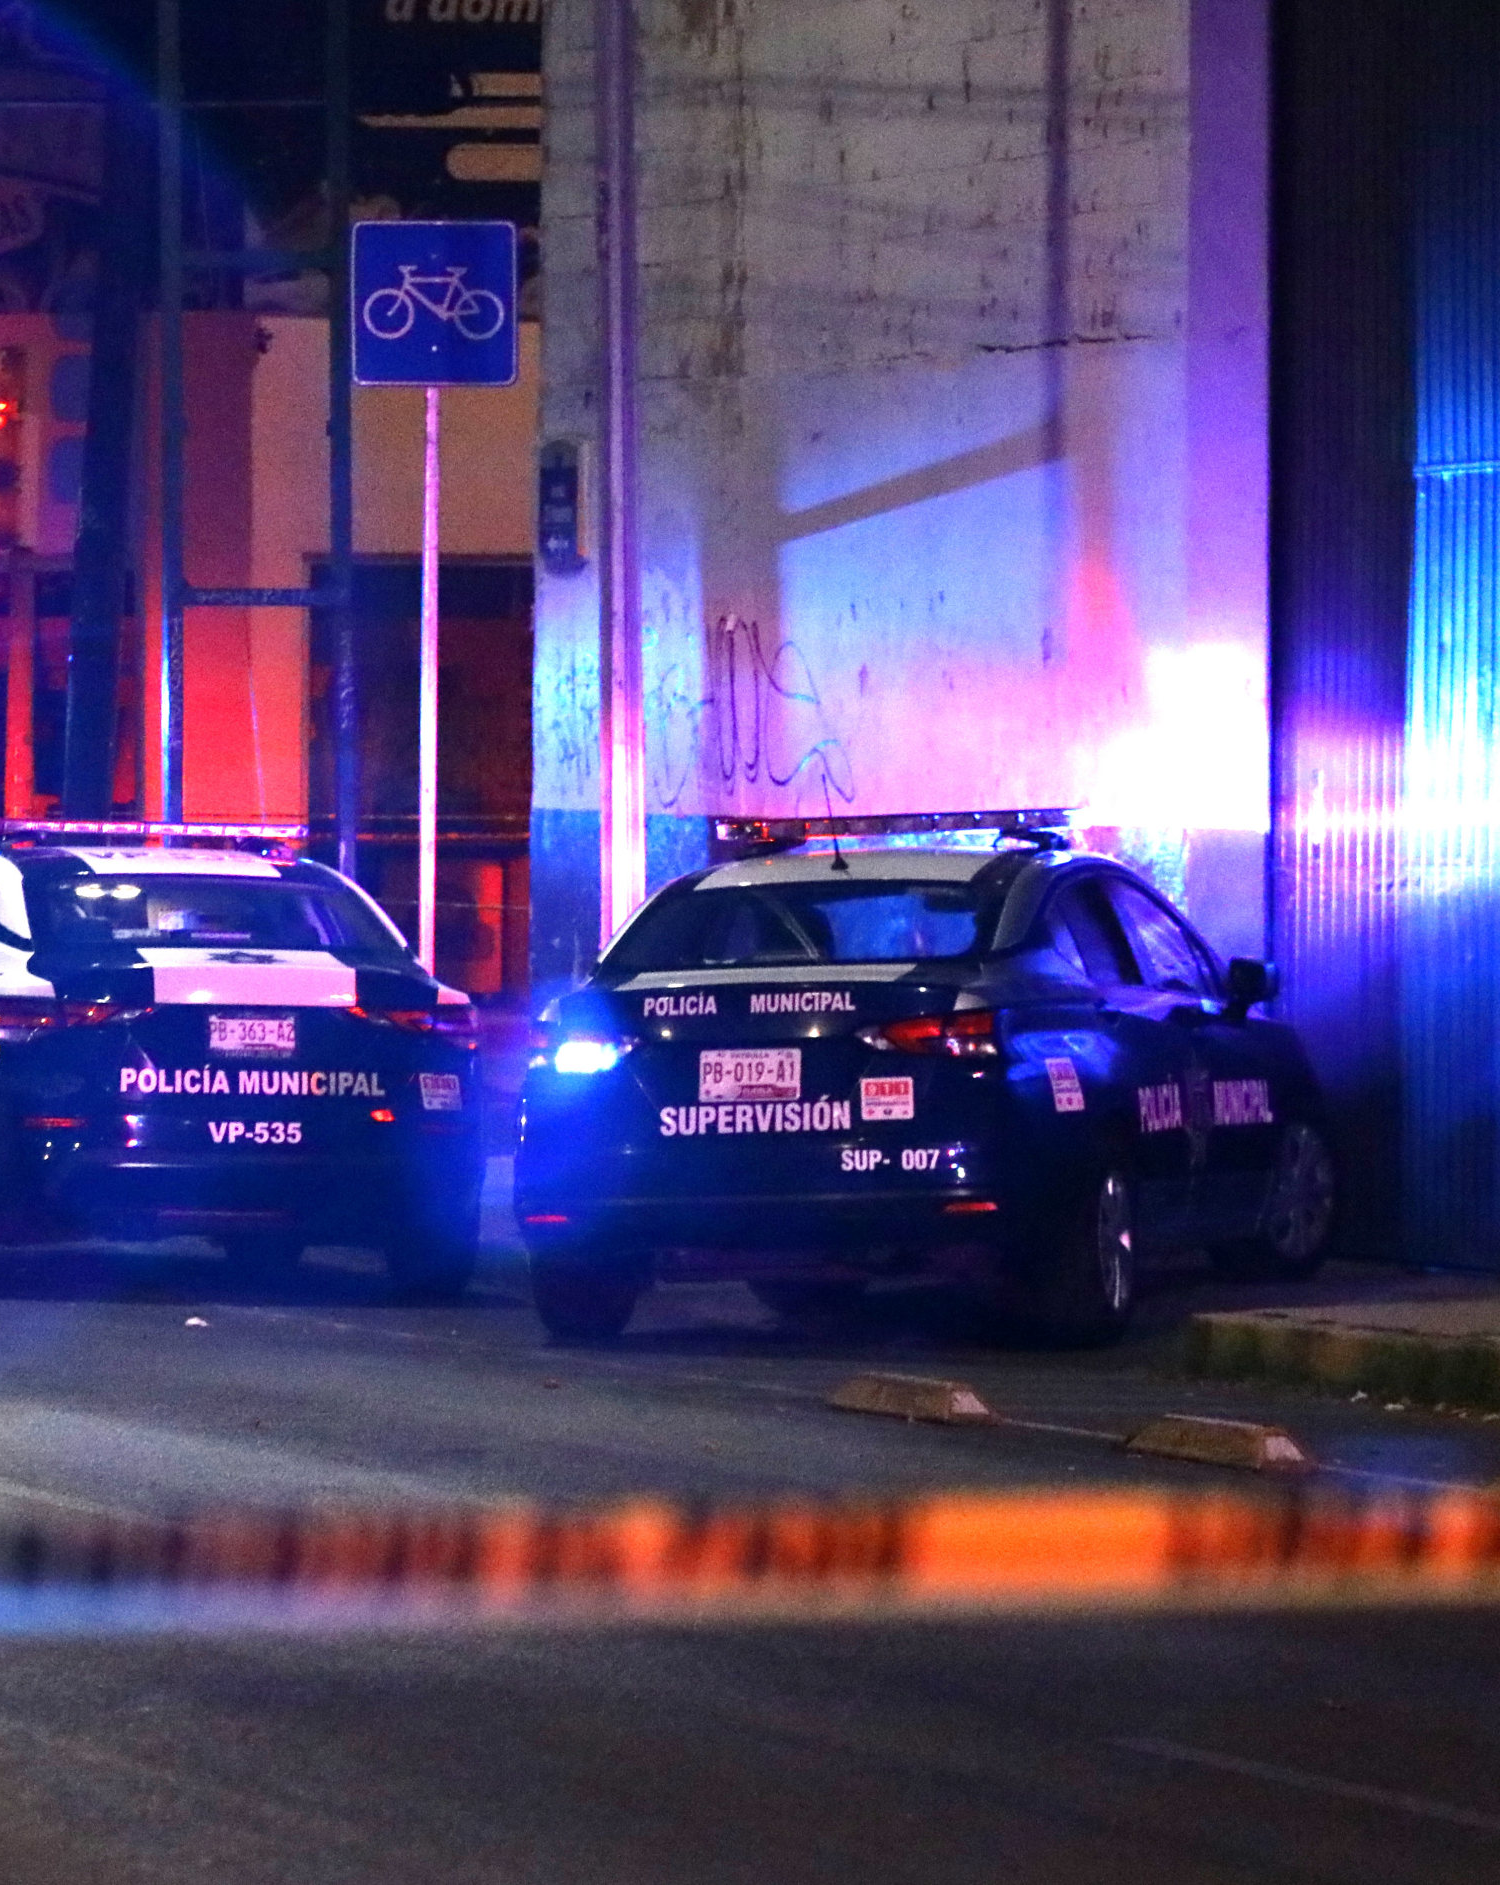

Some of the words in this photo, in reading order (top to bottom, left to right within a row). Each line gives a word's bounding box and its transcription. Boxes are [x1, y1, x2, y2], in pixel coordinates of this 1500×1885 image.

[643, 991, 717, 1017] POLICÍA
[750, 992, 856, 1013] MUNICIPAL
[209, 1021, 296, 1042] PB-363-A2
[120, 1064, 230, 1094] POLICÍA
[239, 1070, 385, 1097] MUNICIPAL
[702, 1060, 795, 1084] PB-019-A1
[867, 1083, 907, 1096] 911
[660, 1094, 851, 1136] SUPERVISIÓN
[208, 1121, 302, 1144] VP-535
[841, 1149, 890, 1171] SUP-
[901, 1149, 940, 1170] 007
